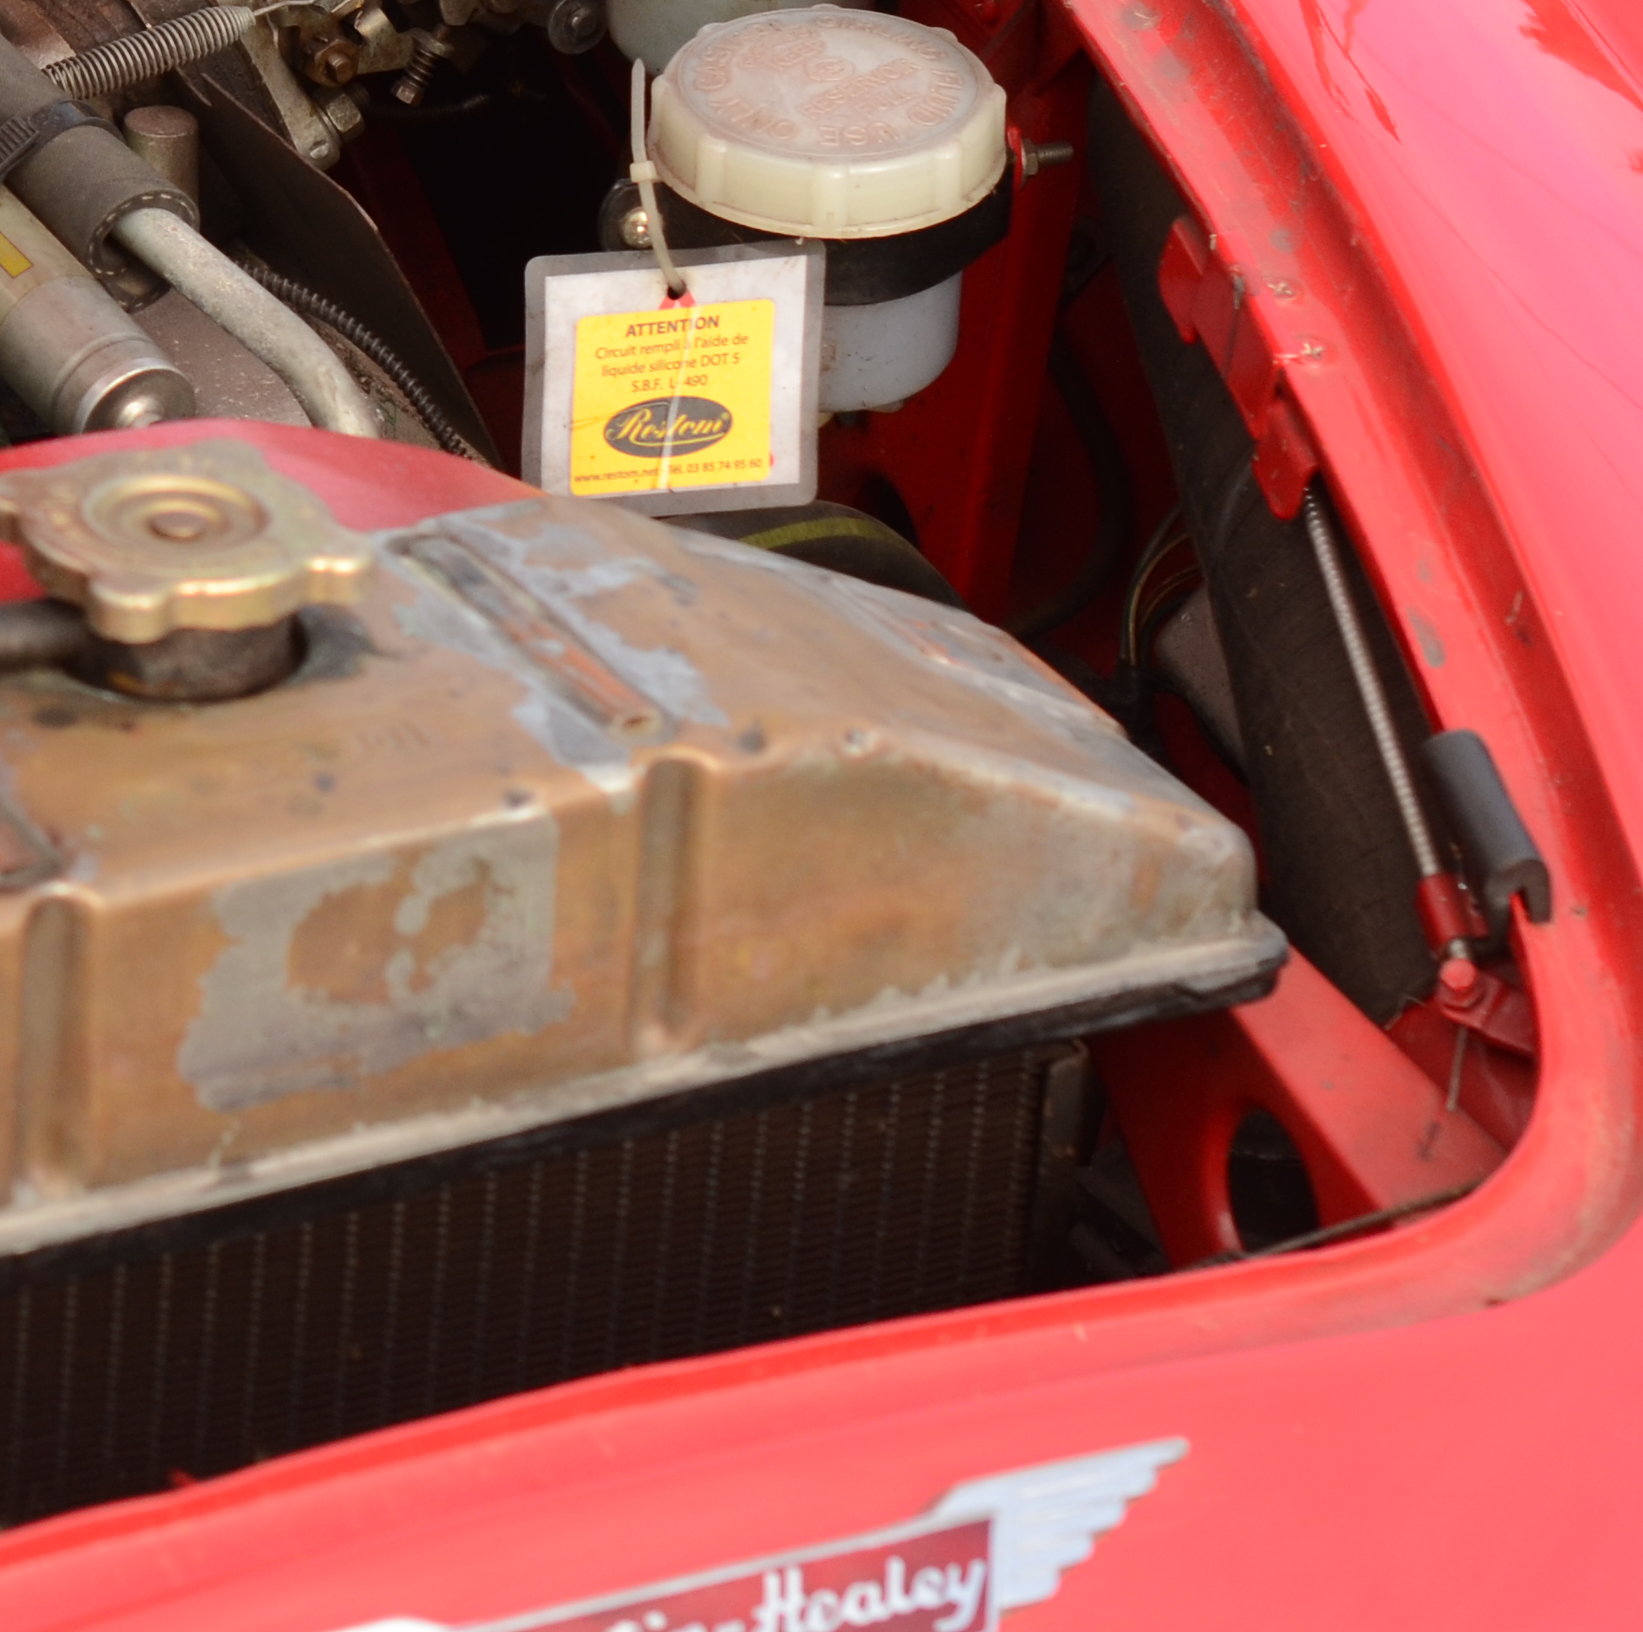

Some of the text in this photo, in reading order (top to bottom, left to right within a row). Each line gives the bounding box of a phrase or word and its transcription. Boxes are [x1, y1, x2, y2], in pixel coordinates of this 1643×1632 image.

[767, 38, 826, 72] KEEP
[853, 88, 921, 120] FULL
[906, 68, 963, 127] FLUID
[708, 98, 802, 141] ONLY
[820, 122, 901, 147] USE
[625, 315, 719, 338] ATTENTION
[595, 344, 636, 360] Circuit
[639, 339, 680, 357] rempli
[694, 333, 729, 349] l'aide
[731, 333, 749, 346] de
[601, 352, 740, 379] liquide silicone DOT 5
[683, 374, 709, 387] 490
[574, 467, 660, 482] www.restom.net
[688, 462, 700, 474] 03
[703, 461, 716, 473] 85
[719, 459, 732, 471] 74
